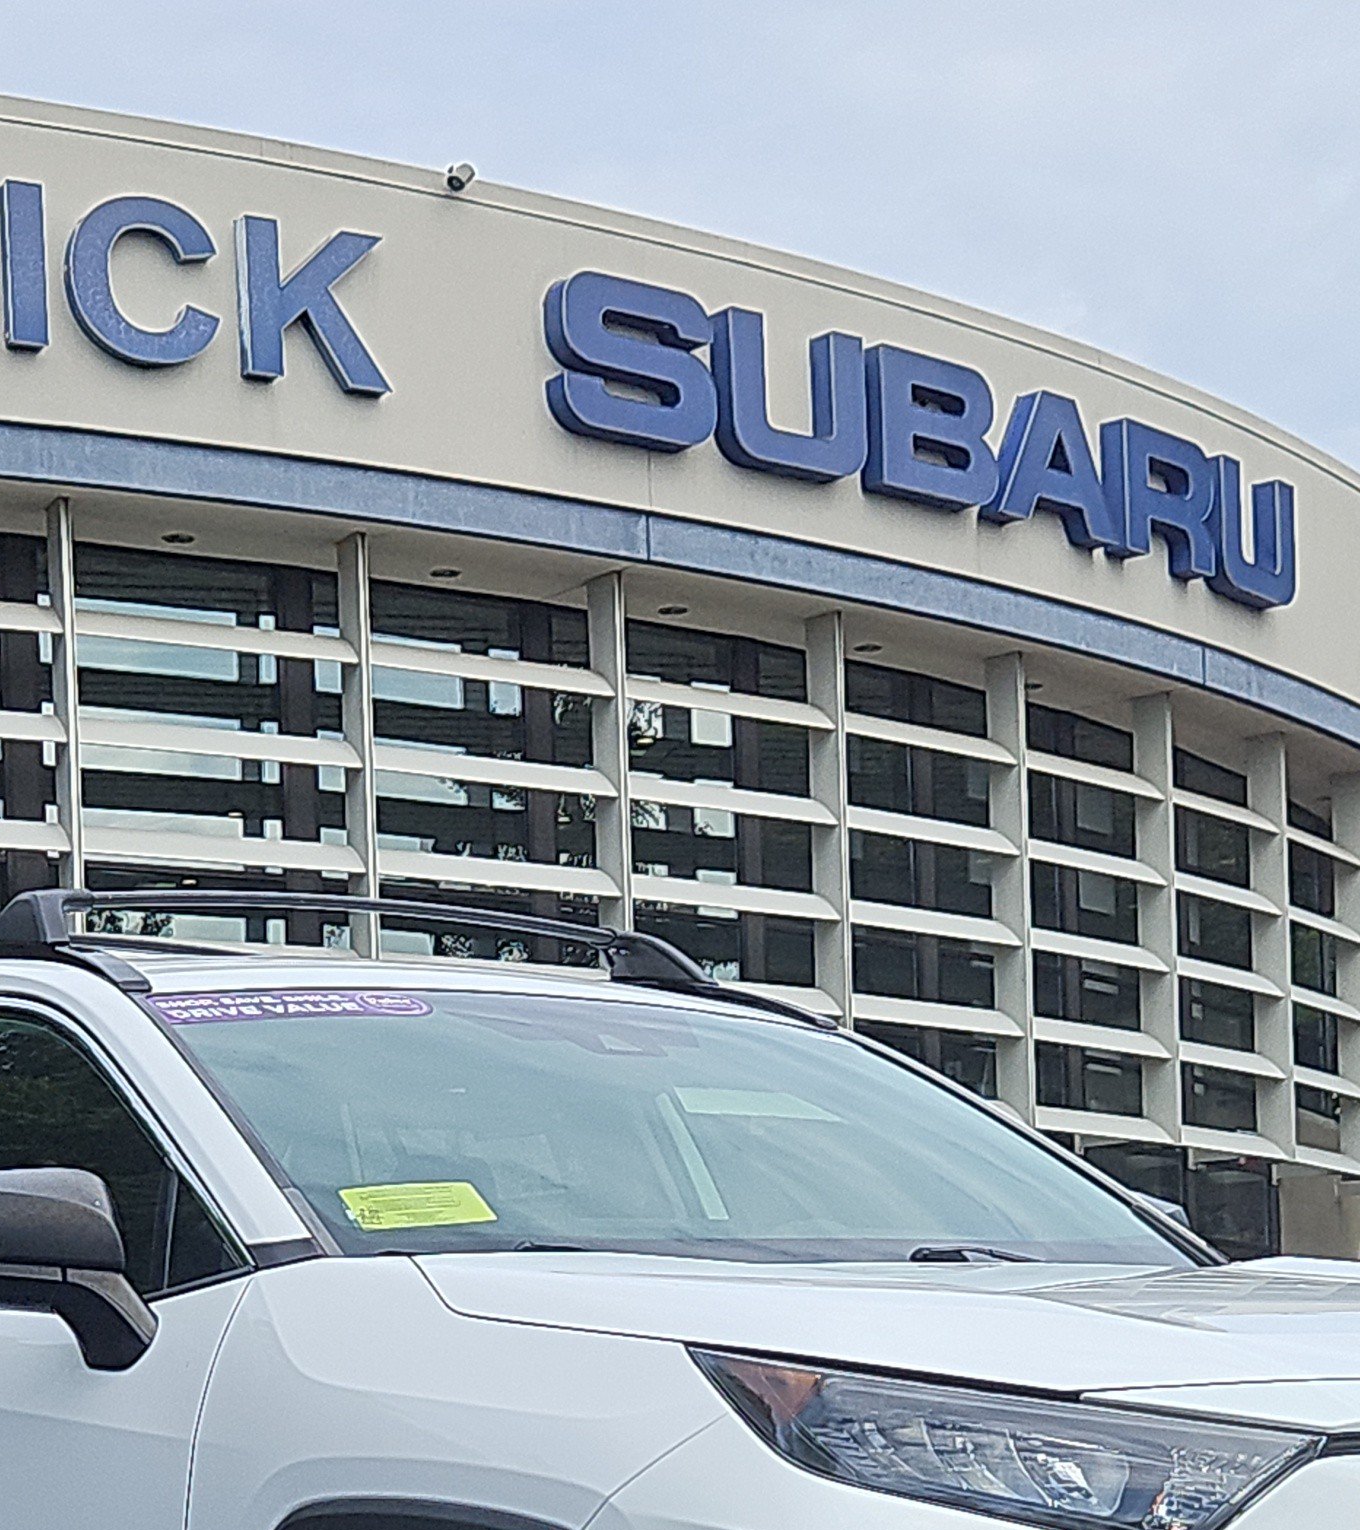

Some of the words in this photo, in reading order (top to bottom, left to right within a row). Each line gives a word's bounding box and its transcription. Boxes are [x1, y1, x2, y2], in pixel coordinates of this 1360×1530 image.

[543, 270, 1296, 610] SUBARU
[162, 1005, 262, 1018] DRIVE
[261, 1001, 364, 1014] VALUE
